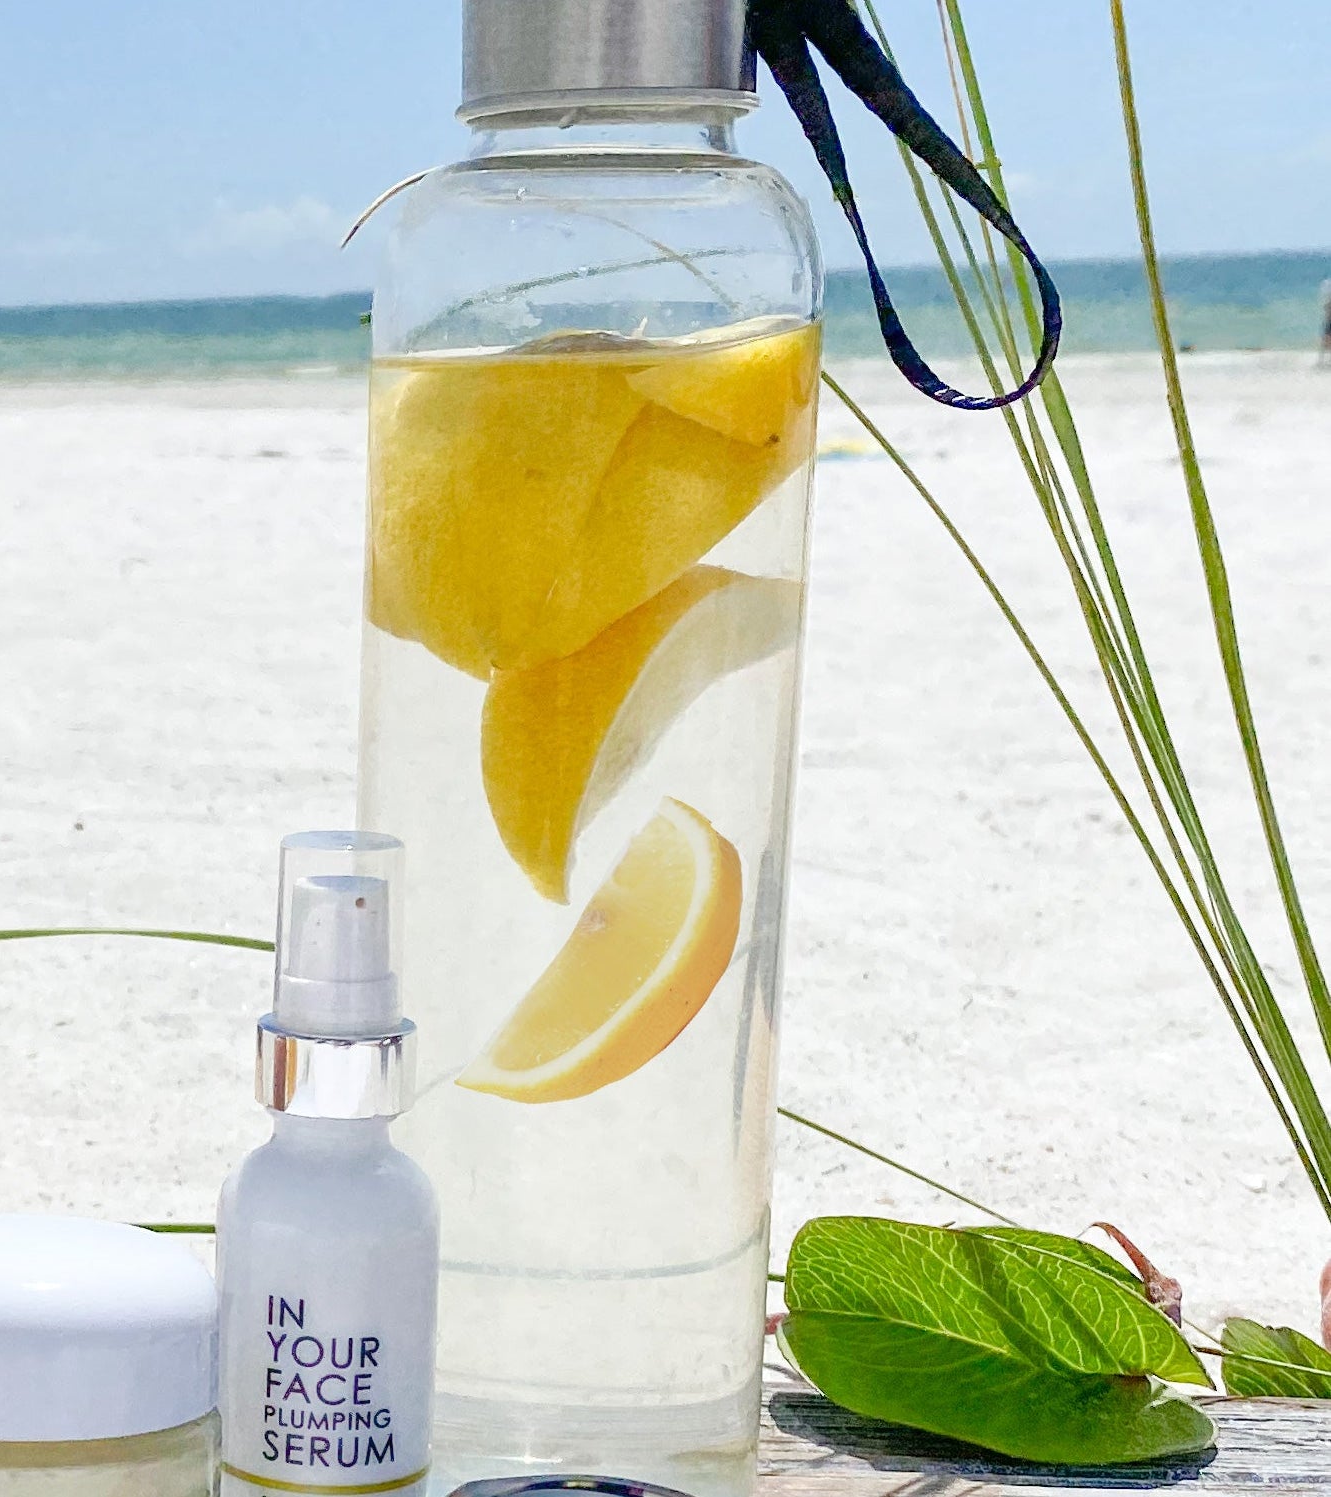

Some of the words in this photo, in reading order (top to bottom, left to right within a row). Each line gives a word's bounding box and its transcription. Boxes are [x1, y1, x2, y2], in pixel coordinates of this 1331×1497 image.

[267, 1294, 305, 1330] IN
[266, 1331, 381, 1369] YOUR
[265, 1367, 373, 1406] FACE
[263, 1404, 392, 1431] PLUMPING
[262, 1430, 396, 1469] SERUM
